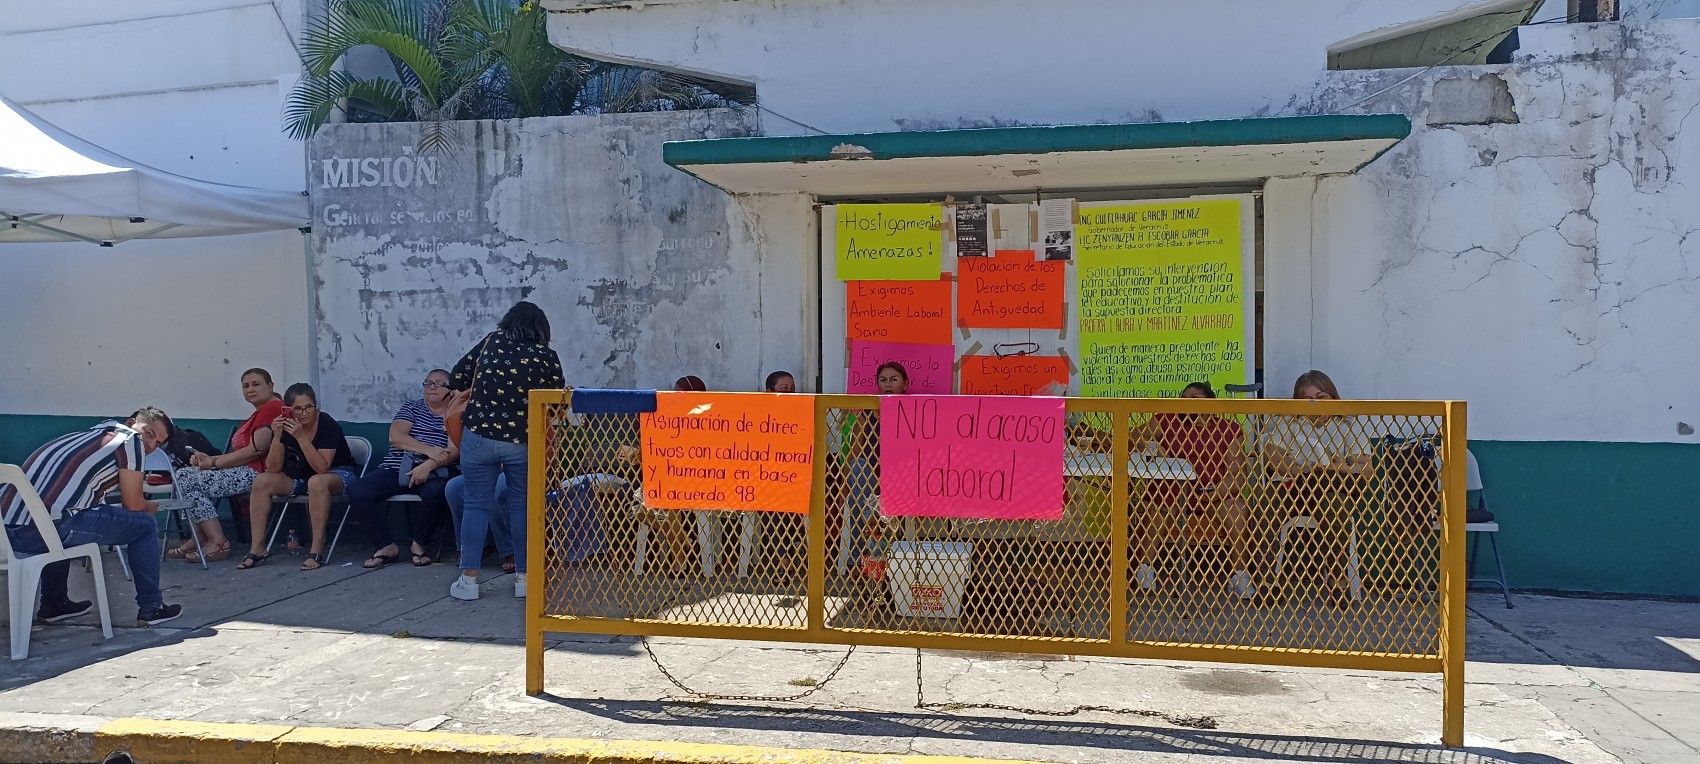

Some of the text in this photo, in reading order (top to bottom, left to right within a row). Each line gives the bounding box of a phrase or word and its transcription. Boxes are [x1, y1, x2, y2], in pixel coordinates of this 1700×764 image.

[1087, 223, 1169, 234] Gobernador de Veracruz
[1147, 229, 1180, 241] ESCOBAR
[1082, 243, 1114, 251] Secretario
[1115, 242, 1123, 250] de
[966, 257, 1055, 273] Violación de los
[1087, 265, 1145, 278] Solicitamos
[1149, 264, 1160, 276] su
[858, 280, 914, 300] Exigimos
[976, 276, 1046, 294] Derechos de
[1081, 278, 1104, 292] para
[1107, 275, 1155, 288] solucionar
[1160, 272, 1168, 286] la
[1083, 287, 1098, 302] que
[1101, 285, 1150, 300] padecemos
[1153, 286, 1163, 295] en
[1167, 283, 1205, 295] nuestro
[1095, 295, 1142, 307] educativo
[1144, 297, 1149, 307] y
[1152, 294, 1161, 306] la
[1226, 291, 1239, 304] de
[849, 300, 943, 318] Ambiente Laboral
[972, 299, 1045, 319] Antiguedad
[1082, 304, 1182, 319] la supuesta directora
[854, 322, 888, 339] Sano
[1146, 315, 1188, 332] MARTINEZ
[1191, 313, 1234, 331] ALVARADO
[1089, 339, 1239, 356] Quien de manera prepotente ha
[928, 355, 939, 371] la
[1083, 353, 1131, 366] violentado
[1132, 352, 1171, 364] nuestros
[1173, 350, 1216, 362] derechos
[981, 357, 1057, 381] Exigimos un
[1081, 364, 1102, 376] rales
[1121, 364, 1143, 375] como
[1145, 360, 1173, 374] abuso
[922, 375, 936, 388] de
[1083, 373, 1115, 385] laboral
[1117, 376, 1123, 386] y
[1125, 373, 1137, 385] de
[645, 411, 730, 439] Asignación
[736, 412, 753, 433] de
[896, 397, 1057, 444] NO al acoso
[647, 436, 813, 465] tivos con calidad moral
[647, 459, 798, 484] y humana en base
[916, 444, 1016, 502] laboral
[647, 480, 756, 503] al acuerdo 98
